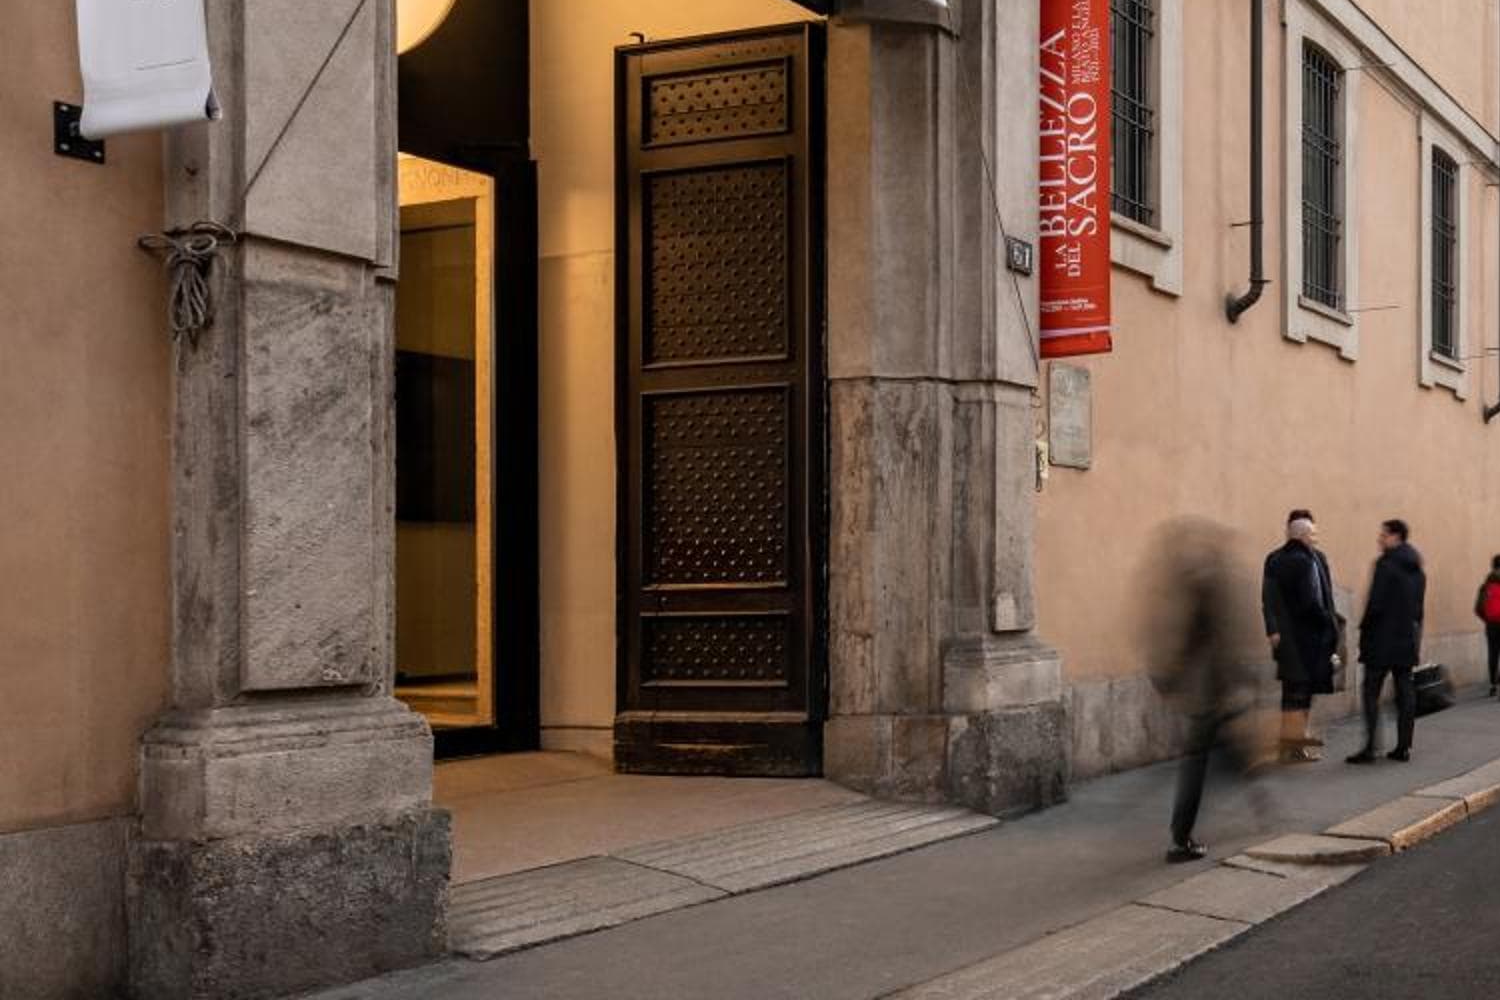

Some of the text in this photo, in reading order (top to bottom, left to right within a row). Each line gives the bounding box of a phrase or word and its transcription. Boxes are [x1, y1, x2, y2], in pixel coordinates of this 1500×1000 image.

[1040, 27, 1067, 270] LA BELLEZZA
[1067, 91, 1098, 237] SACRO
[1067, 243, 1082, 278] DEL
